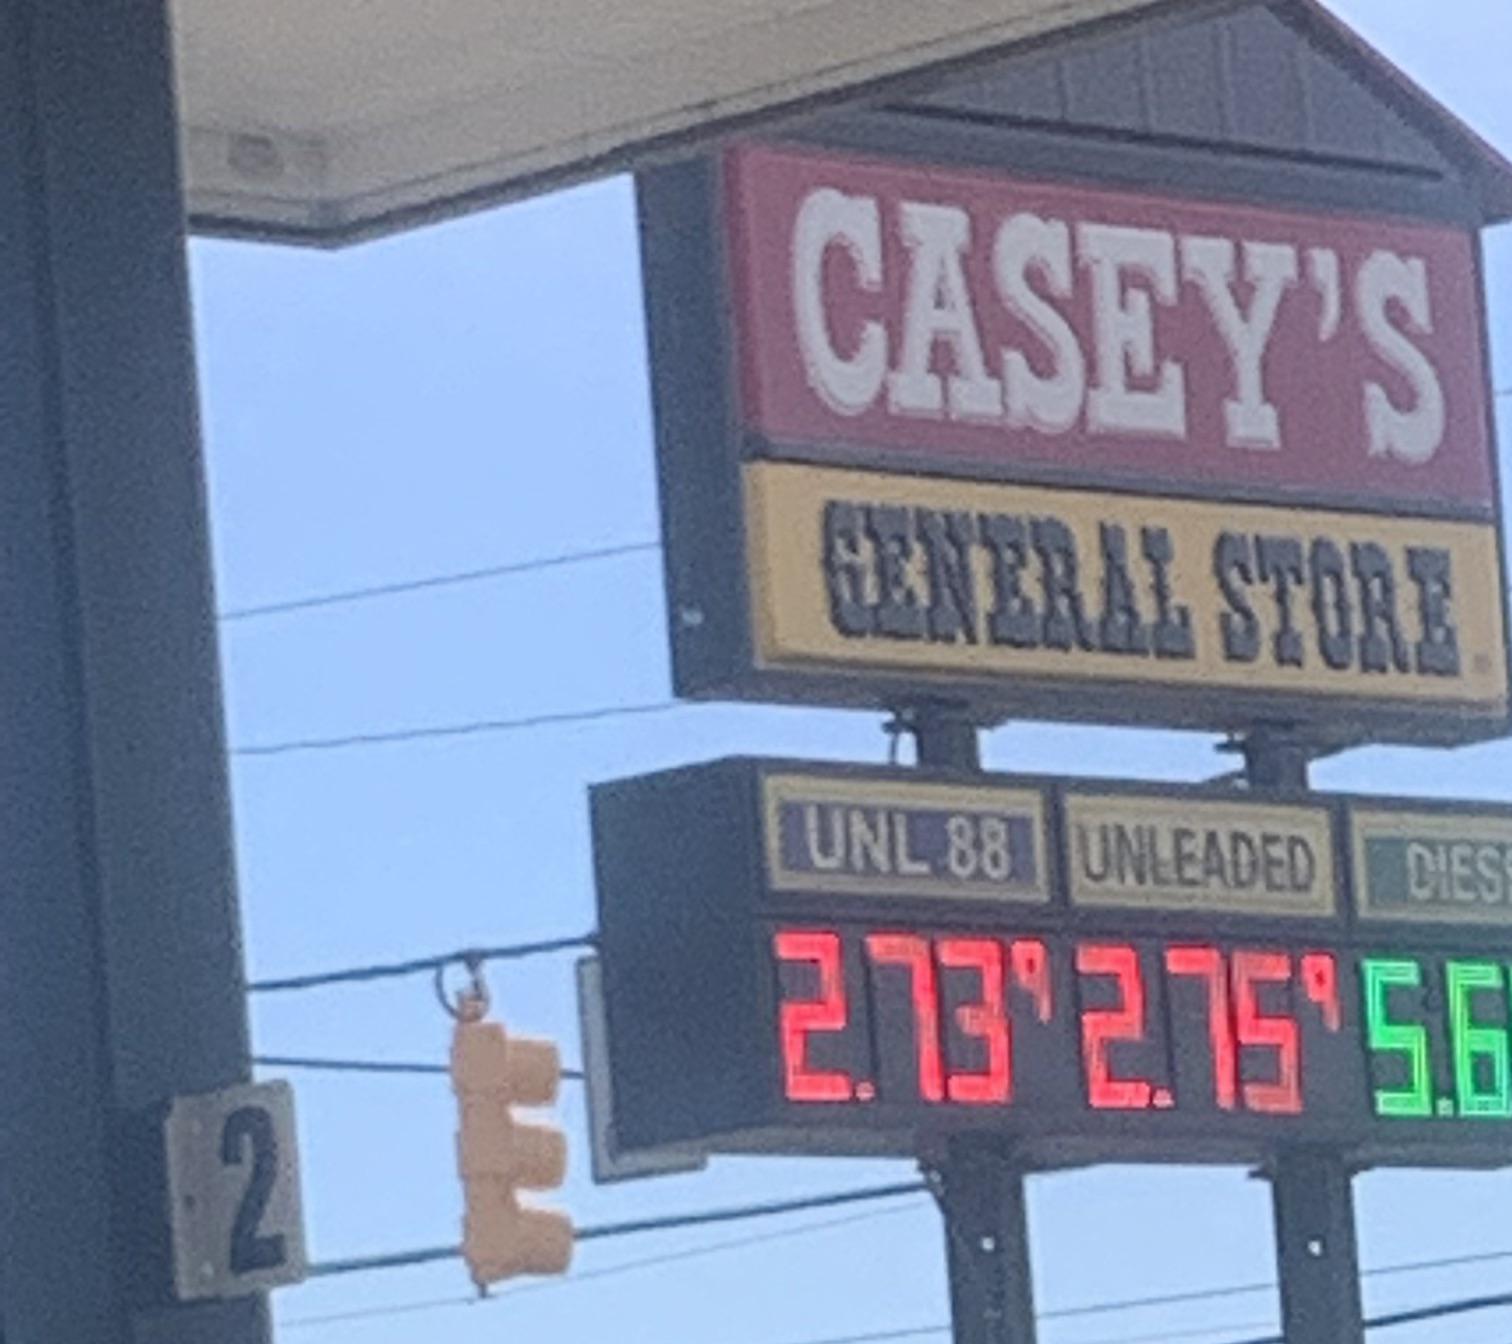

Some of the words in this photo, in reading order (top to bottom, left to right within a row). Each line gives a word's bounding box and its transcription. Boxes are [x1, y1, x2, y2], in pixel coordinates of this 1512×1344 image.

[792, 186, 1447, 464] CASEY'S
[820, 500, 1195, 661] GENERAL
[1212, 529, 1462, 678] STORE
[805, 805, 929, 875] UNL
[946, 816, 1012, 879] 88
[1076, 823, 1316, 893] UNLEADED
[222, 1105, 287, 1275] 2
